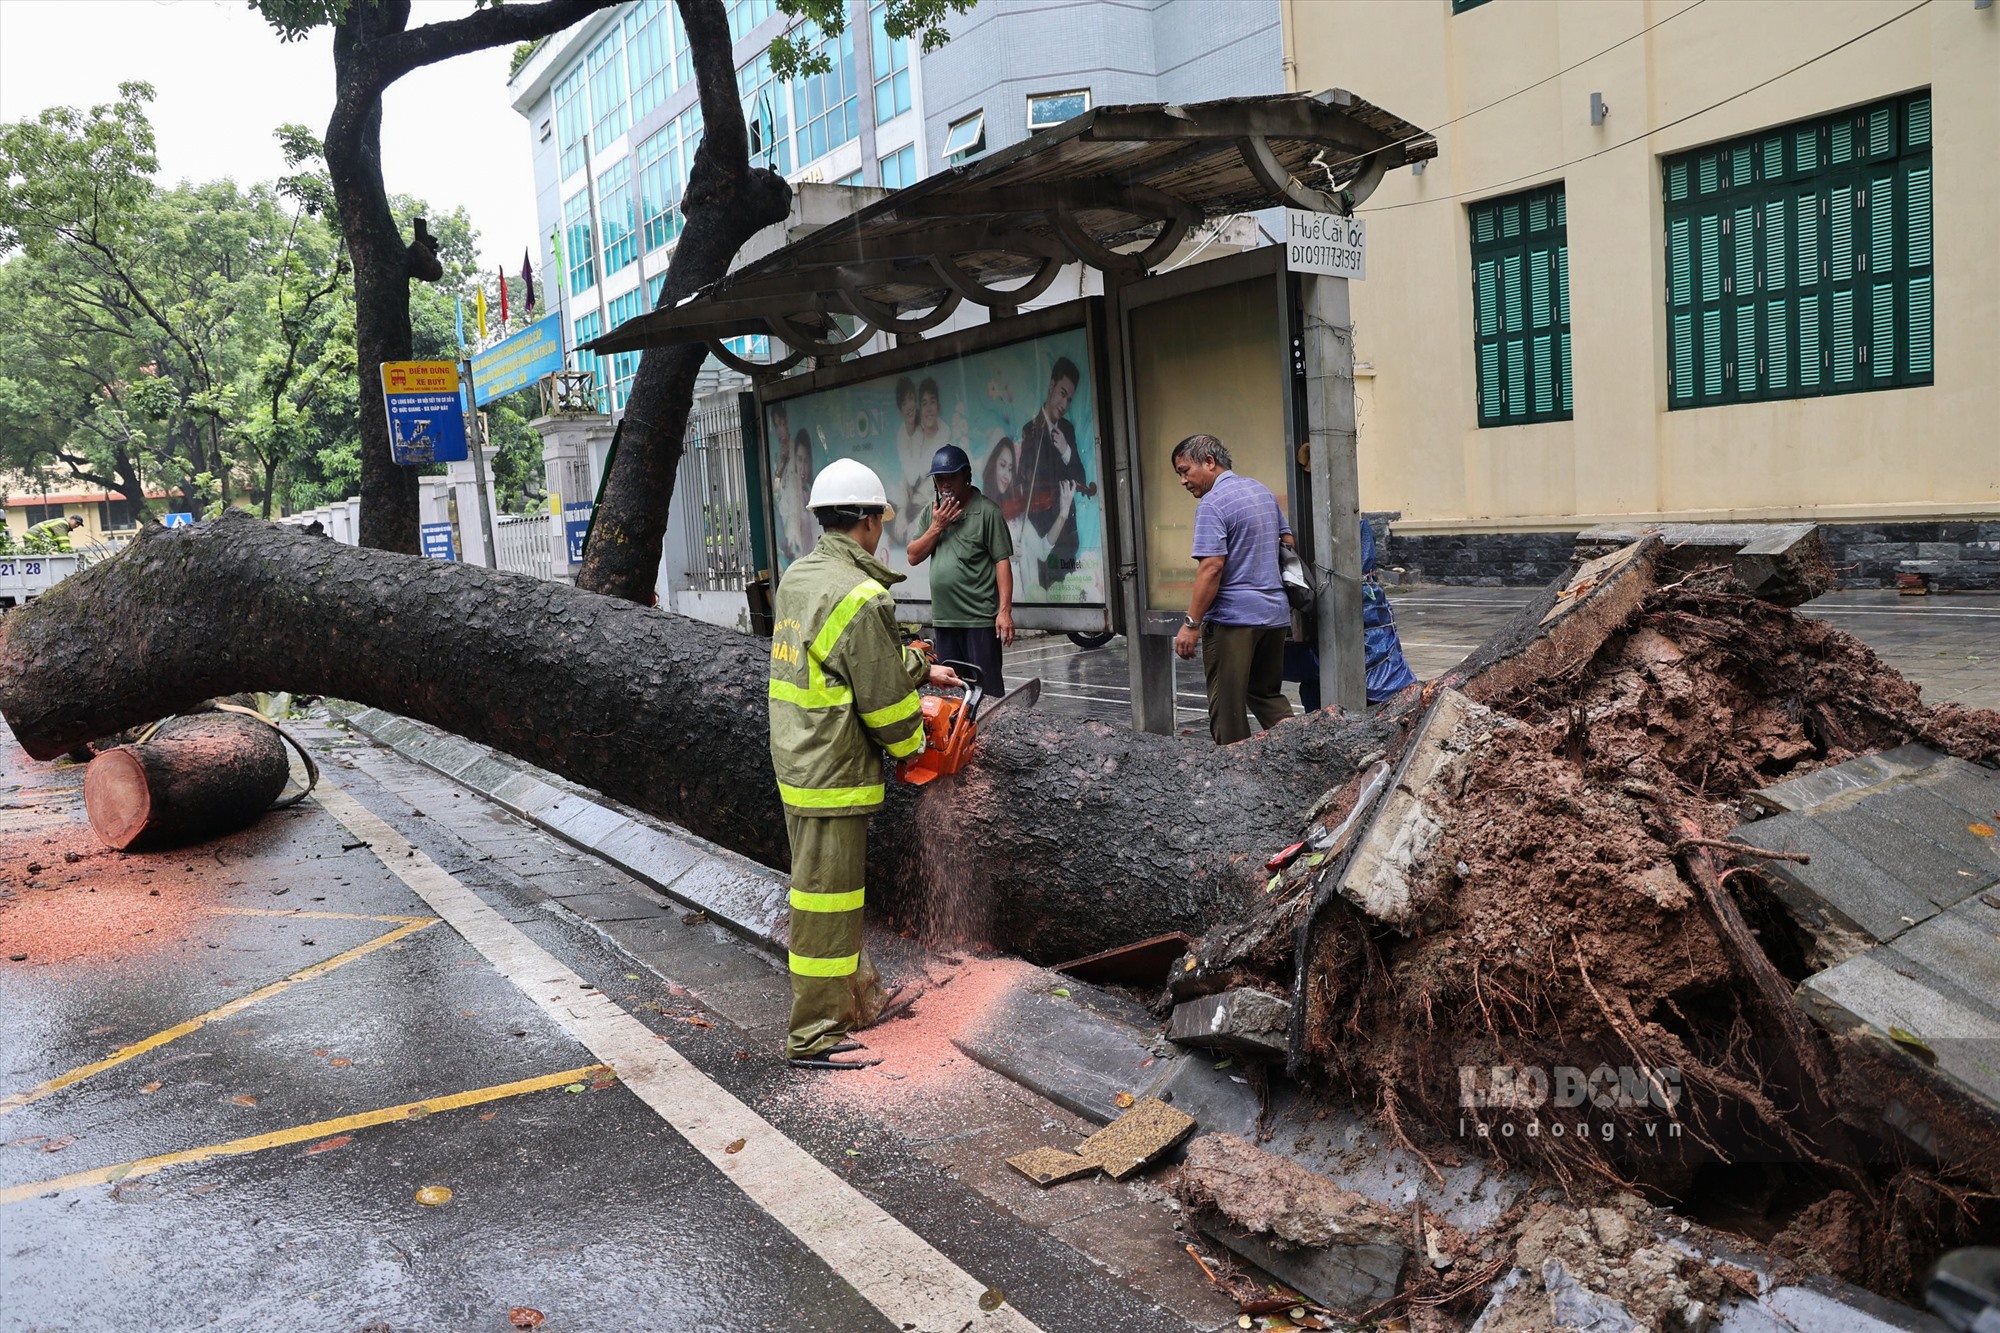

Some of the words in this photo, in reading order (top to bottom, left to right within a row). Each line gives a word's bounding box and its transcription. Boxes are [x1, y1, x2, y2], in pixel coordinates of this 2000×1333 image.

[1291, 214, 1321, 239] Huế
[1345, 219, 1363, 247] Tóc
[409, 365, 428, 374] ĐIỂM
[430, 366, 450, 374] DỪNG
[428, 376, 446, 386] BUÝT
